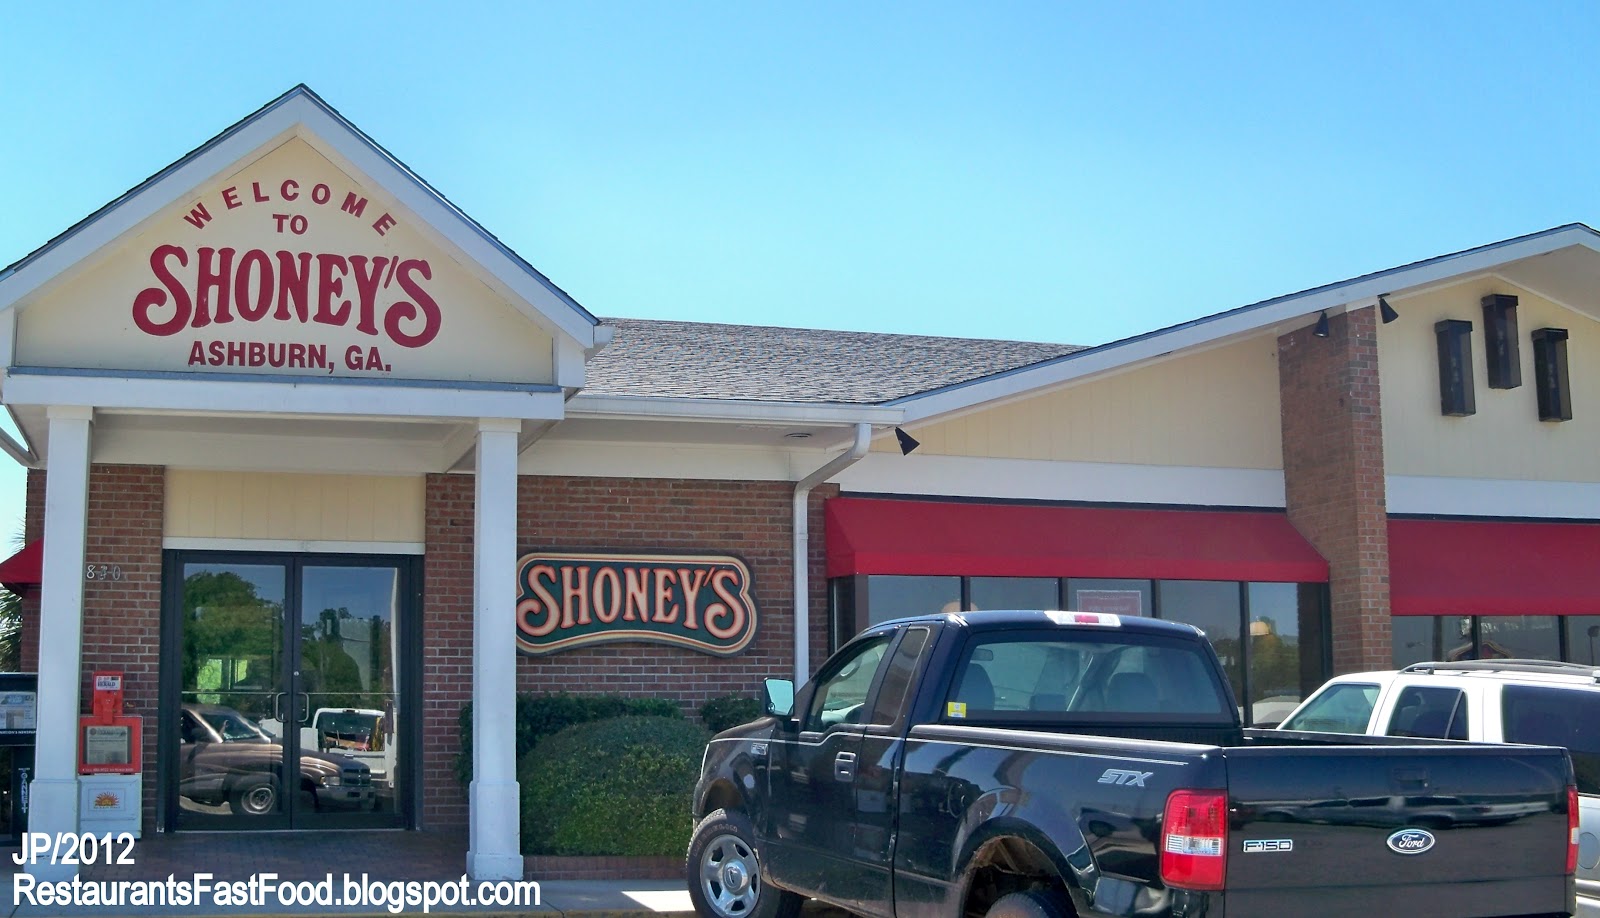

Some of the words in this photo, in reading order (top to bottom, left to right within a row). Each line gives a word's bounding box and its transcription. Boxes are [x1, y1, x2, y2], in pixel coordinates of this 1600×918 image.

[184, 179, 397, 237] WELCOME
[272, 213, 309, 236] TO
[132, 244, 442, 349] SHONEY'S
[188, 340, 335, 374] ASHBURN,
[345, 345, 392, 372] GA.
[516, 564, 745, 639] SHONEY'S
[1097, 768, 1153, 788] STX
[1398, 834, 1425, 848] Ford
